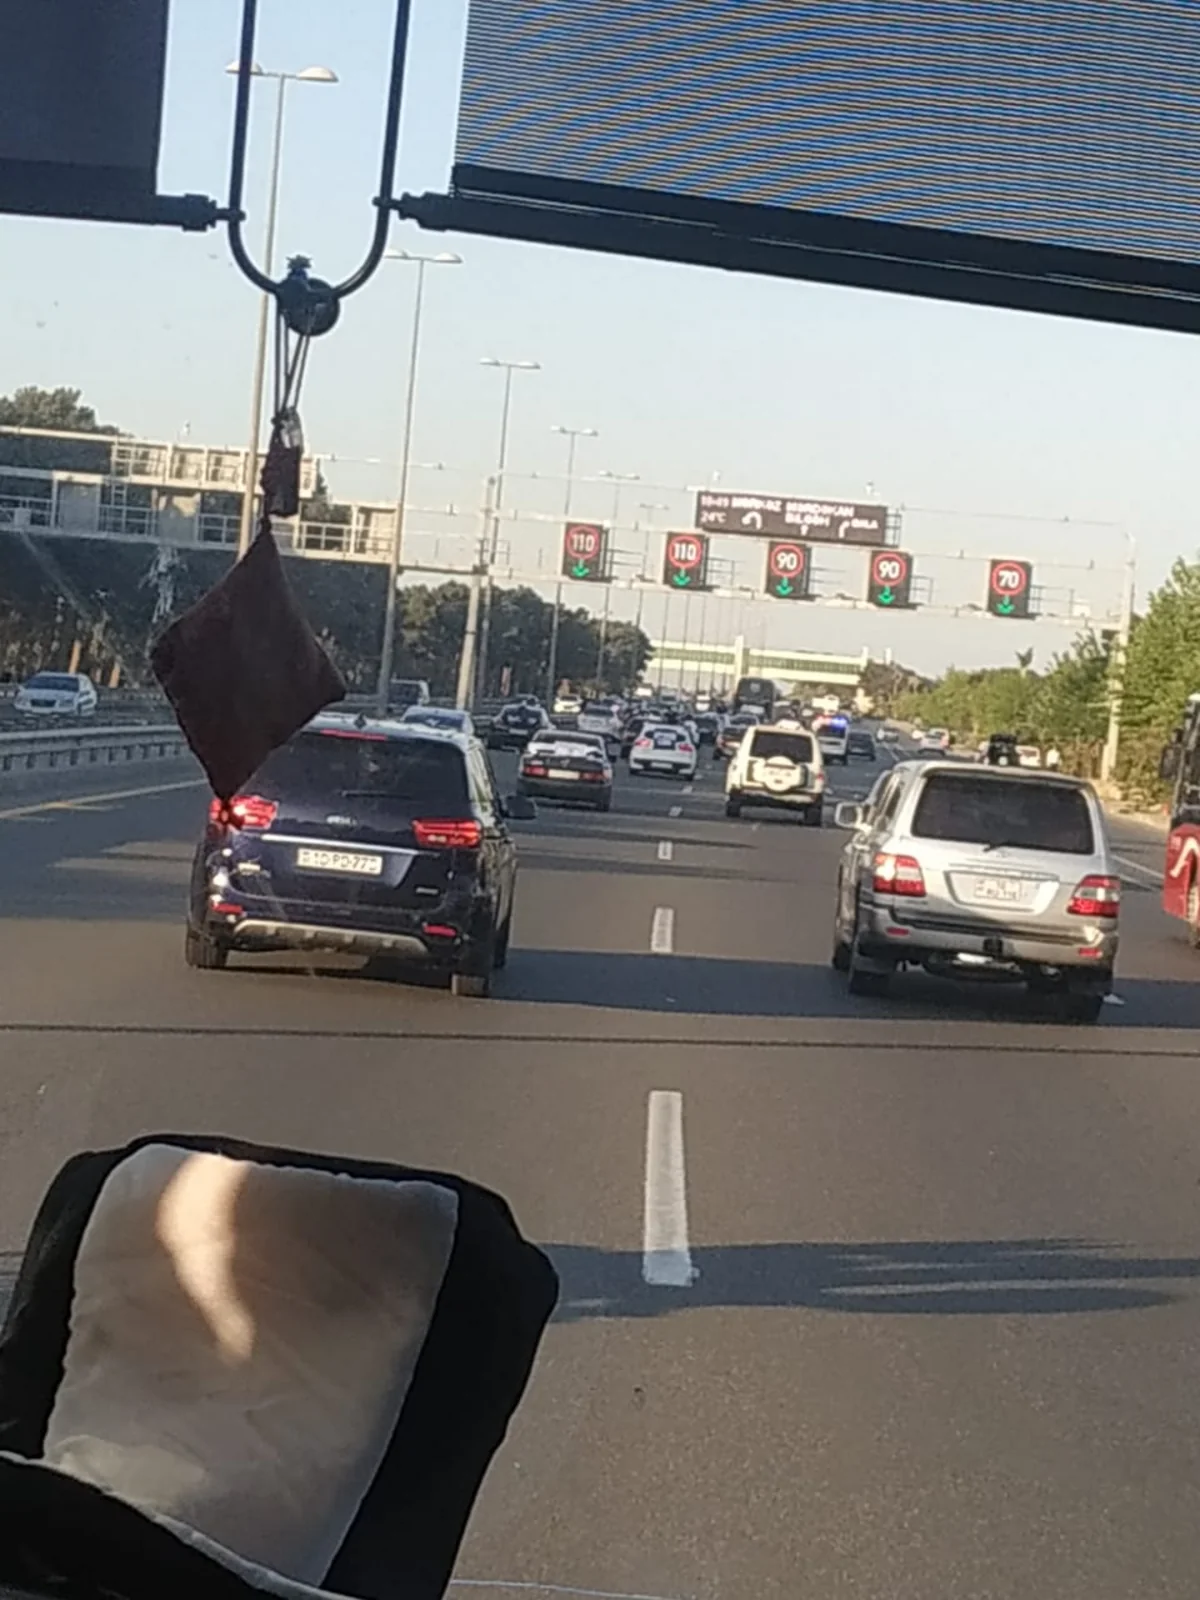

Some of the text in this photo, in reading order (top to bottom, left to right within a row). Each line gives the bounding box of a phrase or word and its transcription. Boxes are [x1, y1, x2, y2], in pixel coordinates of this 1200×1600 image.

[571, 533, 596, 551] 110
[673, 542, 697, 560] 110
[776, 551, 798, 571] 90
[878, 560, 900, 579] 90
[997, 570, 1020, 588] 70
